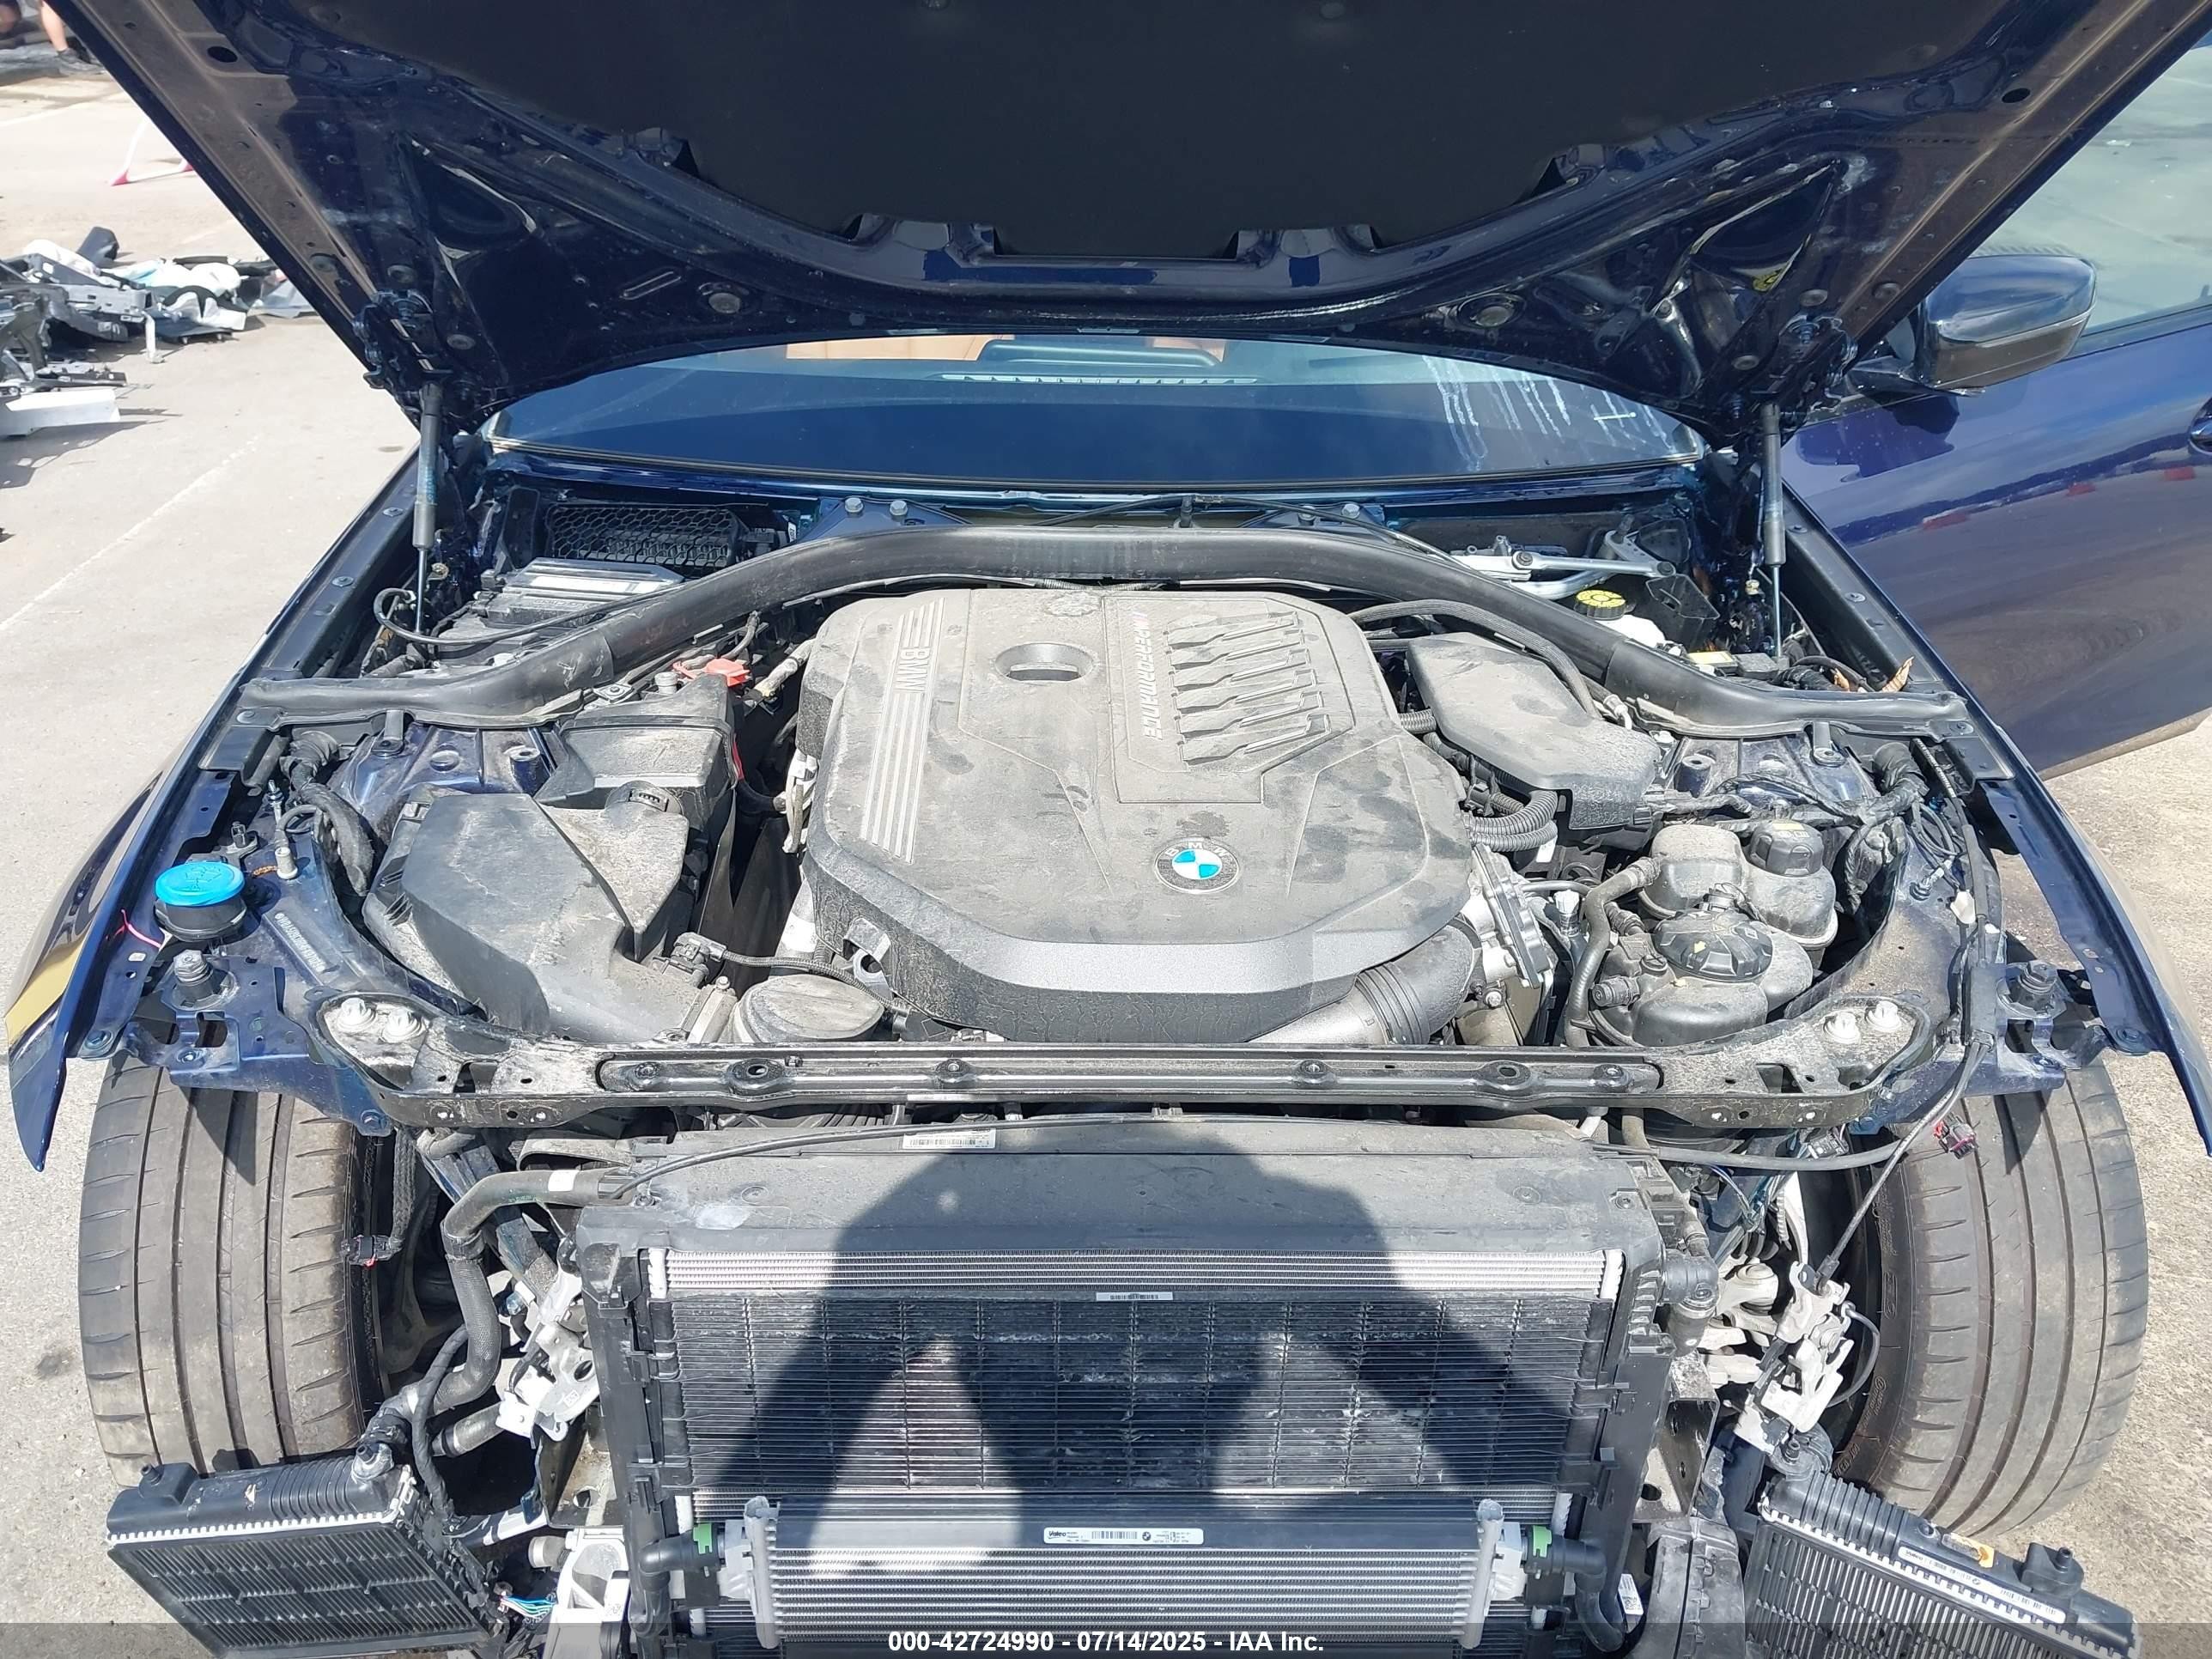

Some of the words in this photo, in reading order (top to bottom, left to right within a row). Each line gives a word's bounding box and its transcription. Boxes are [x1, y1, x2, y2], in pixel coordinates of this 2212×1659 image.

[893, 647, 931, 692] BMW
[1134, 629, 1163, 740] PERFORMANCE
[1164, 841, 1231, 857] BMW
